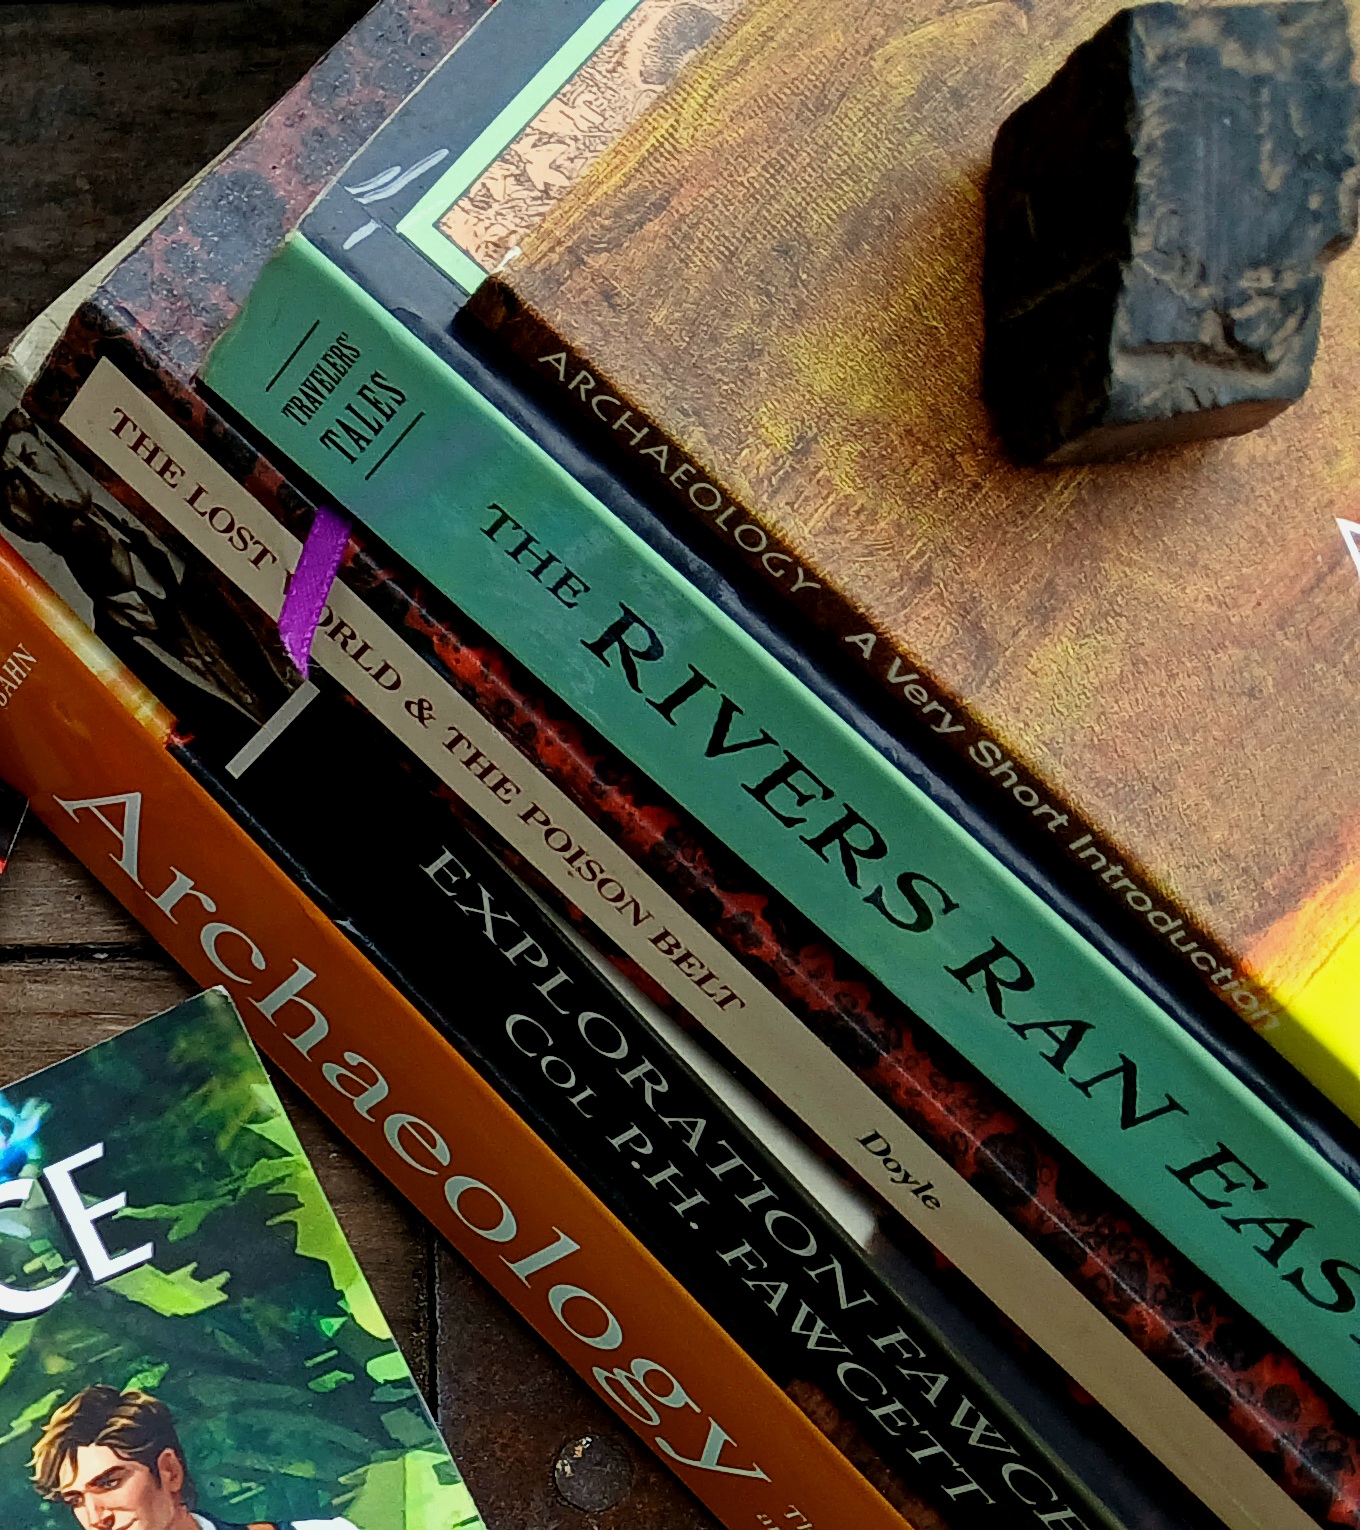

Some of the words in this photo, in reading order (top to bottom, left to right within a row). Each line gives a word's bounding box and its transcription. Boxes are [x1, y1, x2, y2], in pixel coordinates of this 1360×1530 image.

[319, 370, 408, 466] TALES
[537, 349, 822, 592] ARCHAEOLOGY
[843, 632, 882, 661] A
[884, 660, 967, 738] Very
[968, 738, 1071, 837] Short
[1068, 829, 1284, 1034] Introduction
[109, 406, 185, 499] THE
[184, 489, 281, 574] LOST
[284, 569, 404, 694] ORLD
[404, 696, 438, 728] &
[441, 725, 522, 804] THE
[519, 801, 655, 928] POISON
[647, 916, 748, 1016] BELT
[478, 502, 594, 609] THE
[579, 601, 959, 935] RIVERS
[944, 935, 1190, 1130] RAN
[1163, 1141, 1360, 1345] EAS
[52, 790, 772, 1484] Archaeology
[419, 845, 878, 1313] EXPLORATION
[504, 1012, 604, 1120] COL
[605, 1122, 712, 1231] P.H.
[716, 1230, 997, 1509] FAWCETT
[857, 1129, 943, 1213] Doyle
